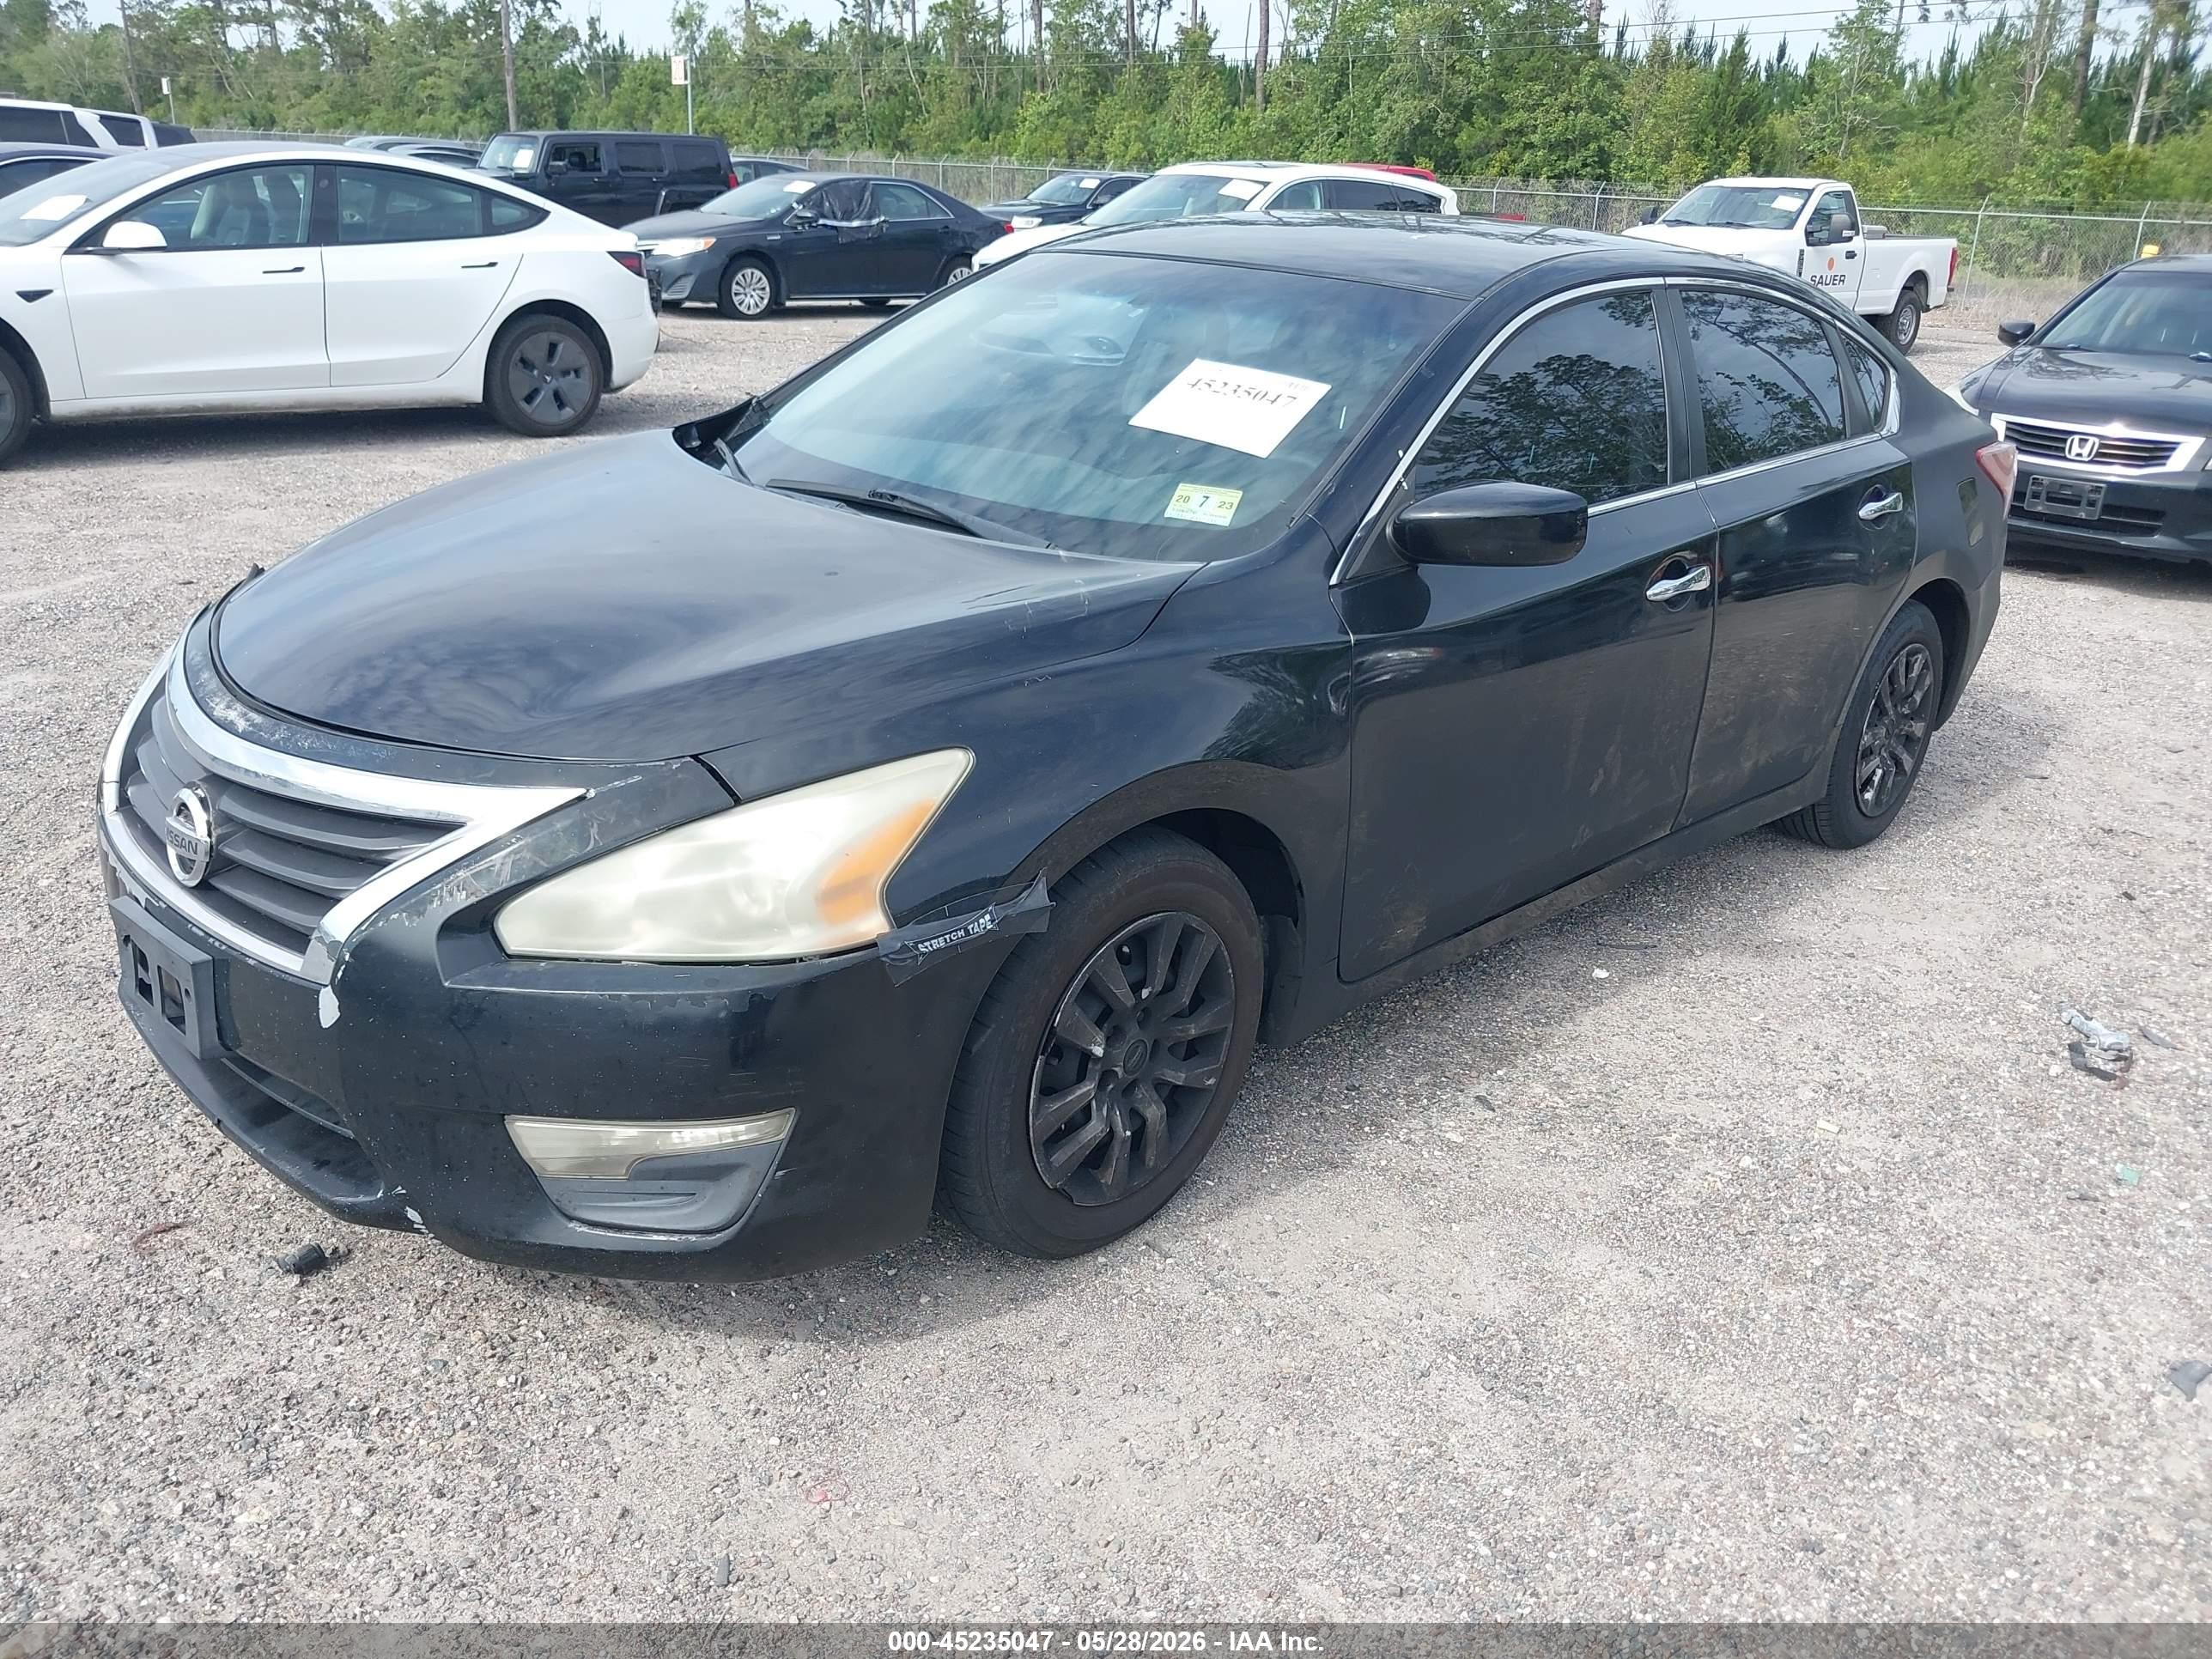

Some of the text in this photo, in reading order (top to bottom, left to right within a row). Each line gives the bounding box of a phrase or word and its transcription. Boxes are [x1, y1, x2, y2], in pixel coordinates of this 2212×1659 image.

[1810, 274, 1846, 288] SAUER
[1187, 378, 1297, 407] 45235047
[1175, 495, 1234, 510] 20 7 23
[166, 827, 198, 855] ISSAN
[917, 913, 994, 954] STRETCH TAPE
